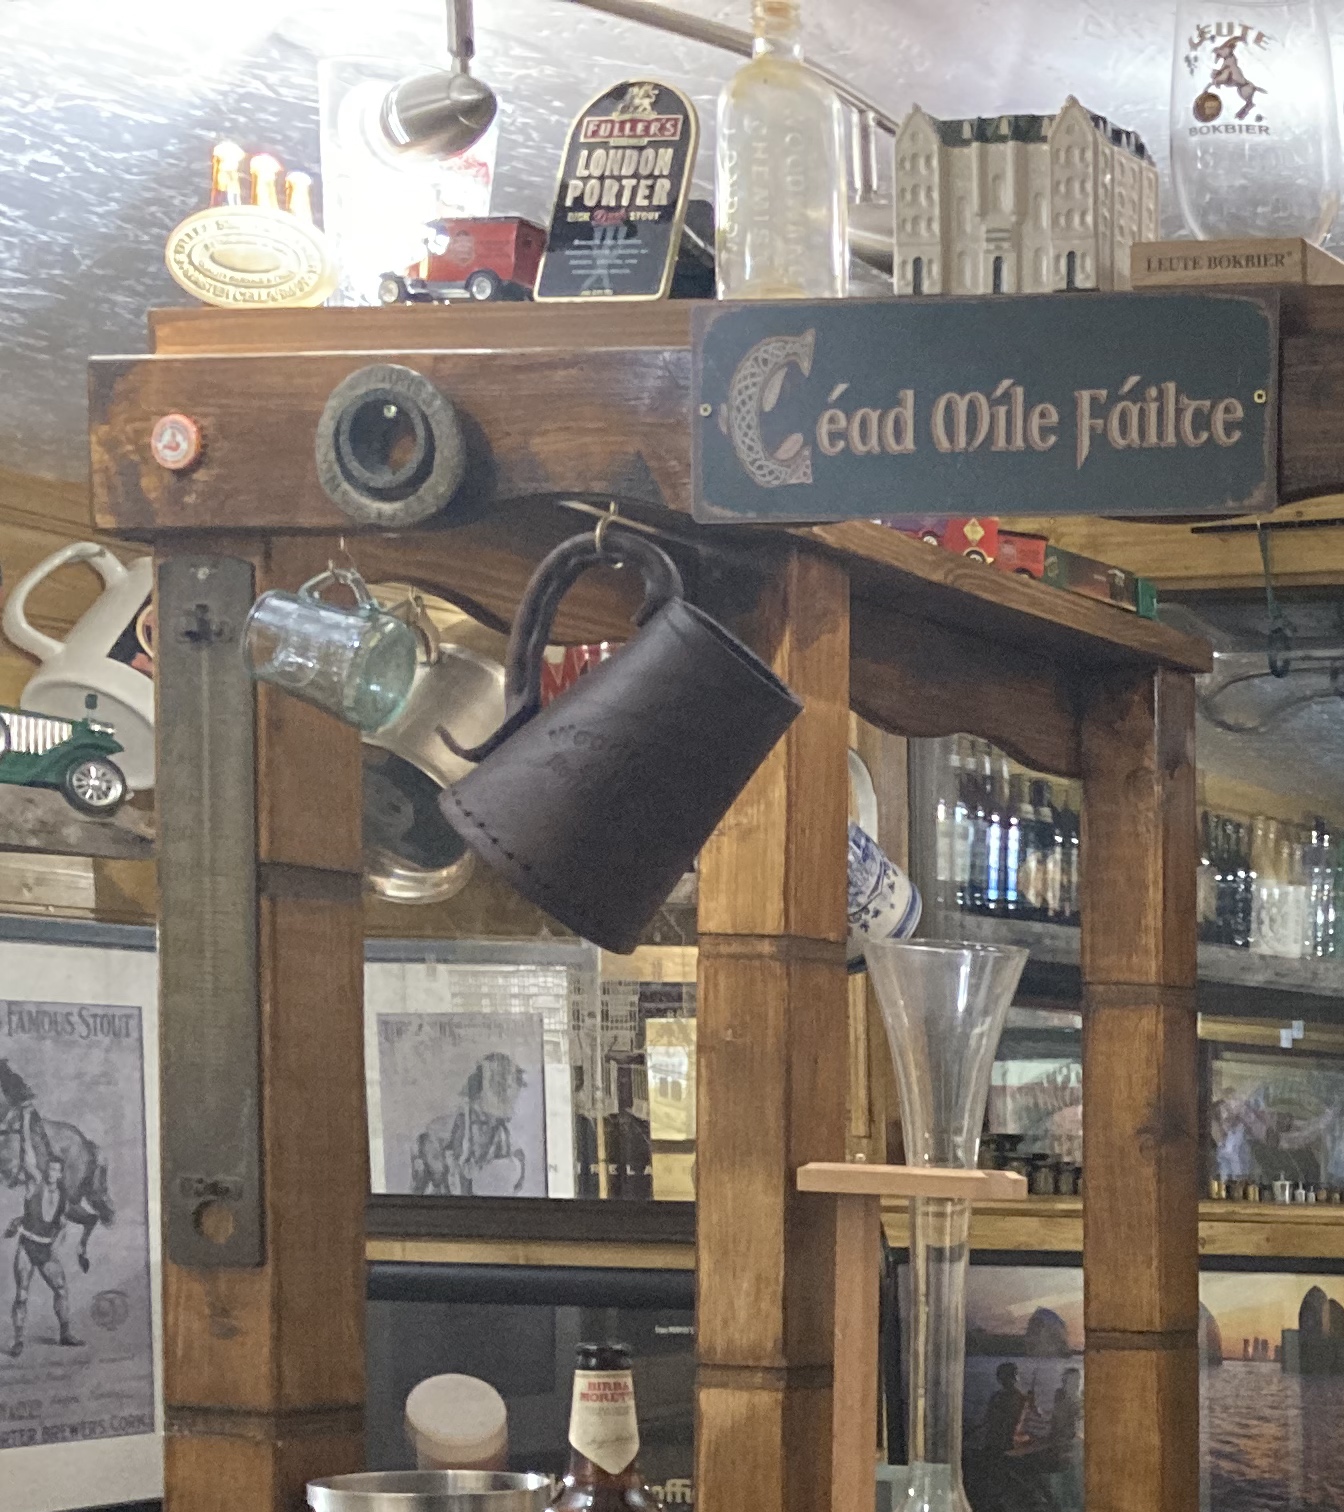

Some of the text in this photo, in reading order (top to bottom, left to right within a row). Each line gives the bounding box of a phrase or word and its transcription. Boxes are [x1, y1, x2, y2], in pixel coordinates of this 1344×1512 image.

[585, 118, 675, 137] FULLER'S
[1188, 124, 1271, 136] BOKBIER
[575, 148, 674, 178] LONDON
[565, 178, 671, 207] PORTER
[1147, 256, 1200, 273] LEUTE
[930, 377, 1059, 453] Míle
[1075, 376, 1244, 470] Fáilte
